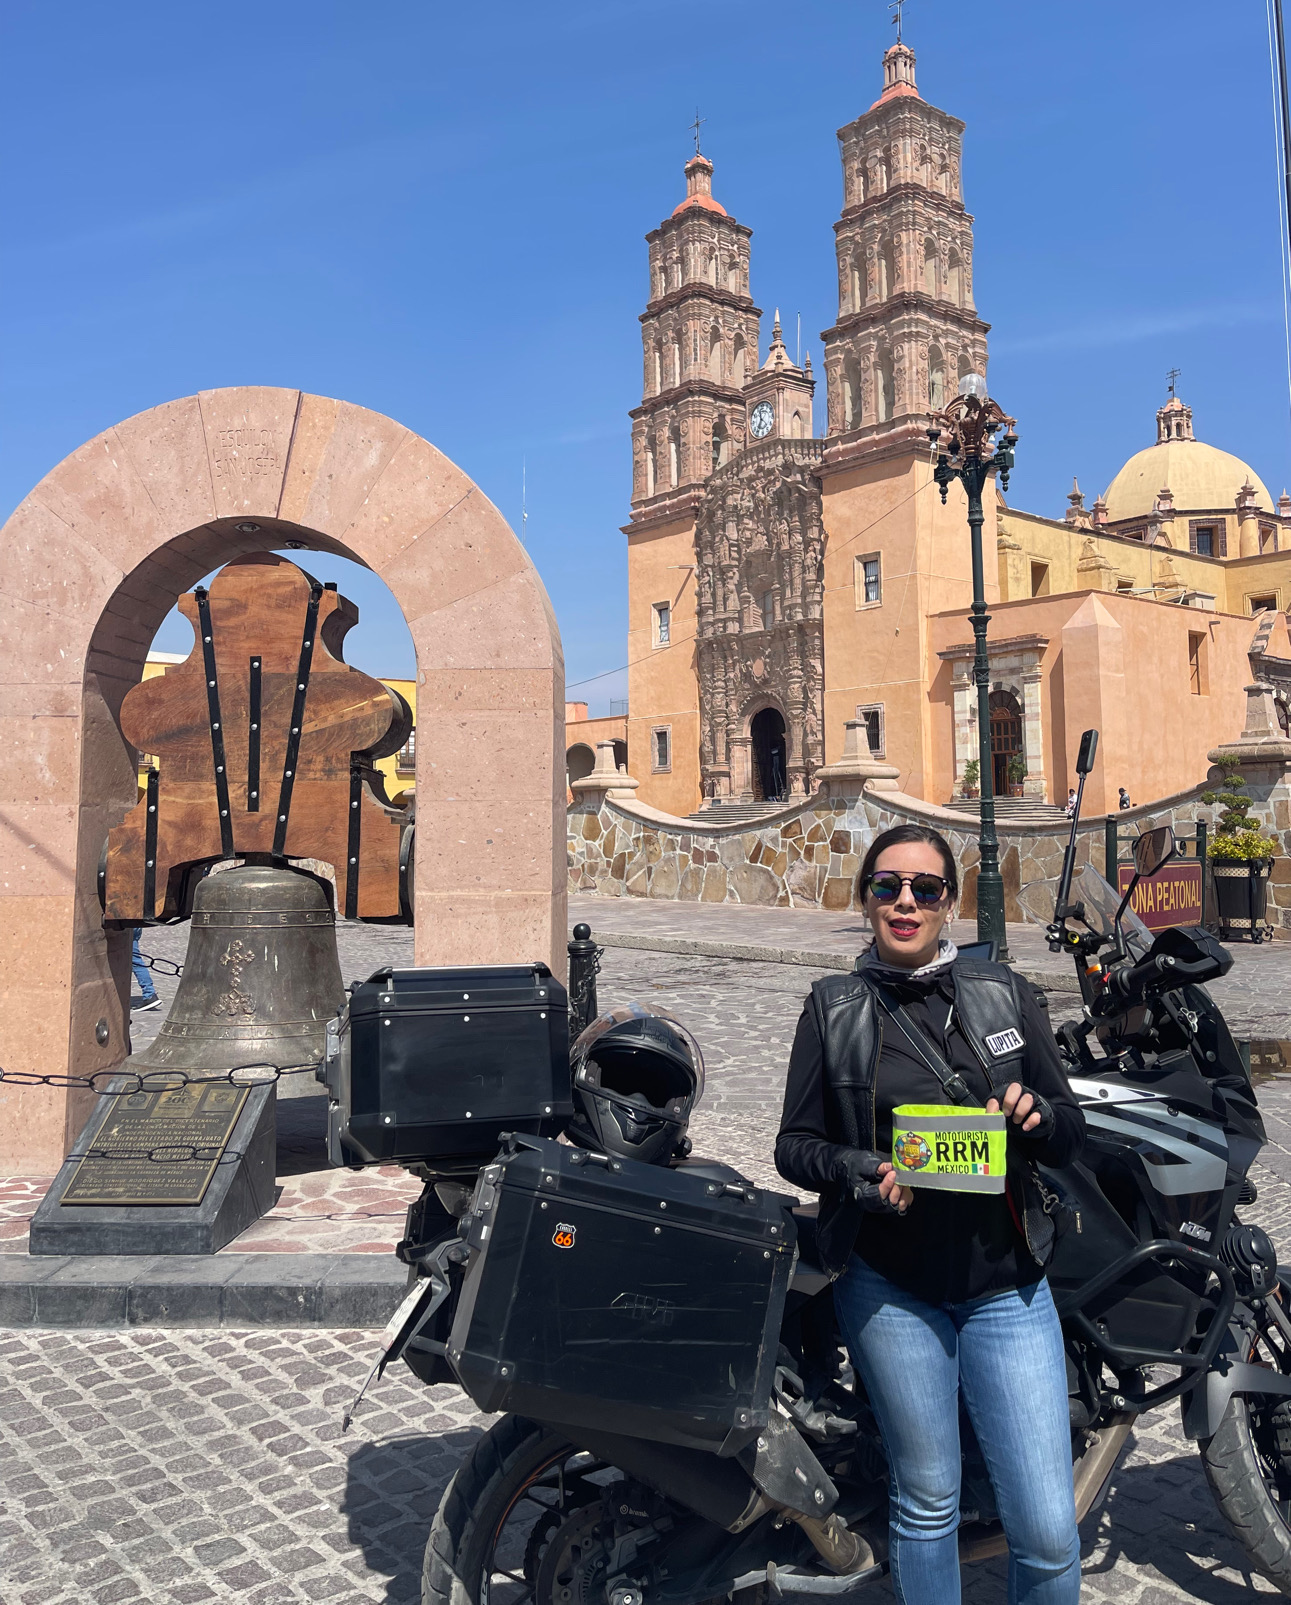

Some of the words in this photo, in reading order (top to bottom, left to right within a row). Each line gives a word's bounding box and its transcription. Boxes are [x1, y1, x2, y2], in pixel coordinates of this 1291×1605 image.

[215, 457, 238, 478] SAN
[1157, 880, 1201, 912] PEATONAL
[987, 1031, 1022, 1053] LUPITA
[935, 1131, 989, 1141] MOTOTURISTA
[936, 1141, 990, 1164] RRM
[937, 1163, 970, 1175] MÉXICO
[555, 1231, 573, 1247] 66
[1179, 1221, 1212, 1242] KTM
